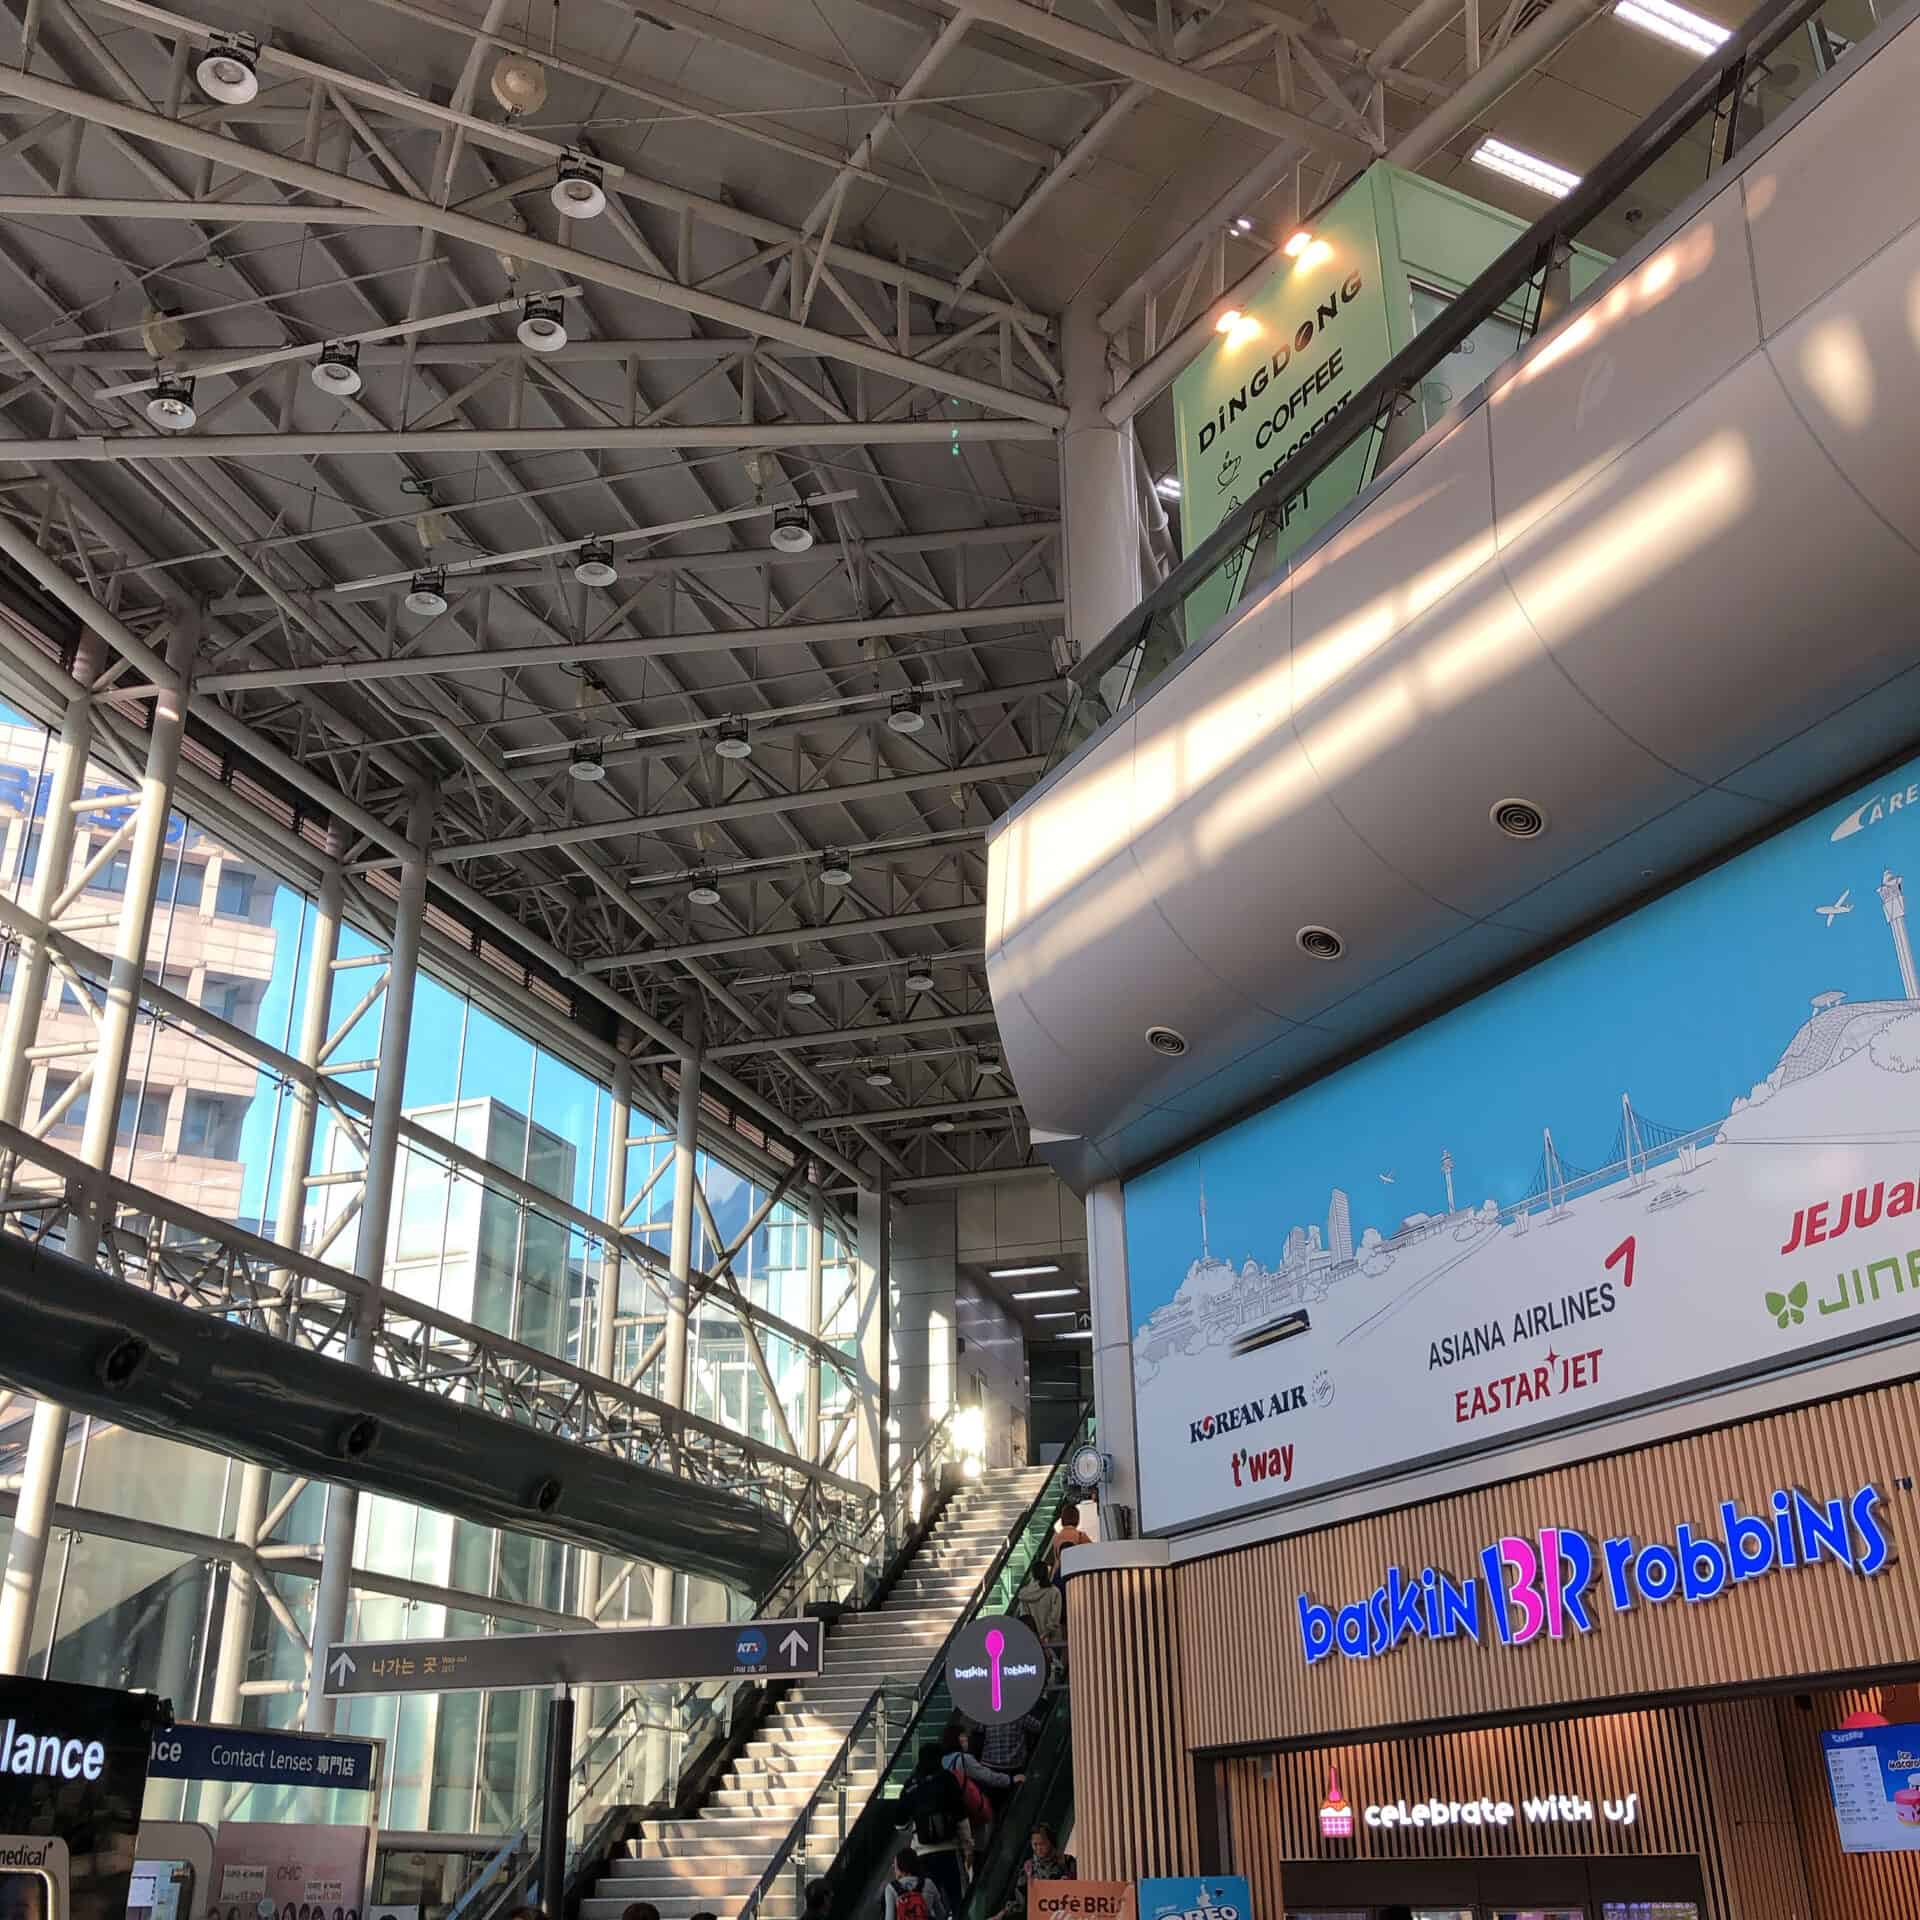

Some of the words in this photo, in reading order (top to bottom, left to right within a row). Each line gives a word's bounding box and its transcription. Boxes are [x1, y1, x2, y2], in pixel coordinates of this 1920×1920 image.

[1255, 347, 1345, 450] COFFEE
[1428, 1320, 1507, 1371] ASIANA
[1512, 1282, 1617, 1343] AIRLINES
[1189, 1398, 1266, 1445] KOREAN
[1267, 1384, 1309, 1418] AIR
[1455, 1365, 1552, 1424] EASTAR
[1558, 1348, 1604, 1395] JET
[1231, 1443, 1295, 1488] t'way
[1480, 1526, 1594, 1646] BR
[372, 1656, 415, 1678] 나가는
[423, 1656, 438, 1675] 곳
[0, 1718, 105, 1781] lance
[211, 1744, 265, 1768] Contact
[270, 1749, 314, 1772] Lenses
[1158, 1905, 1239, 1920] REO
